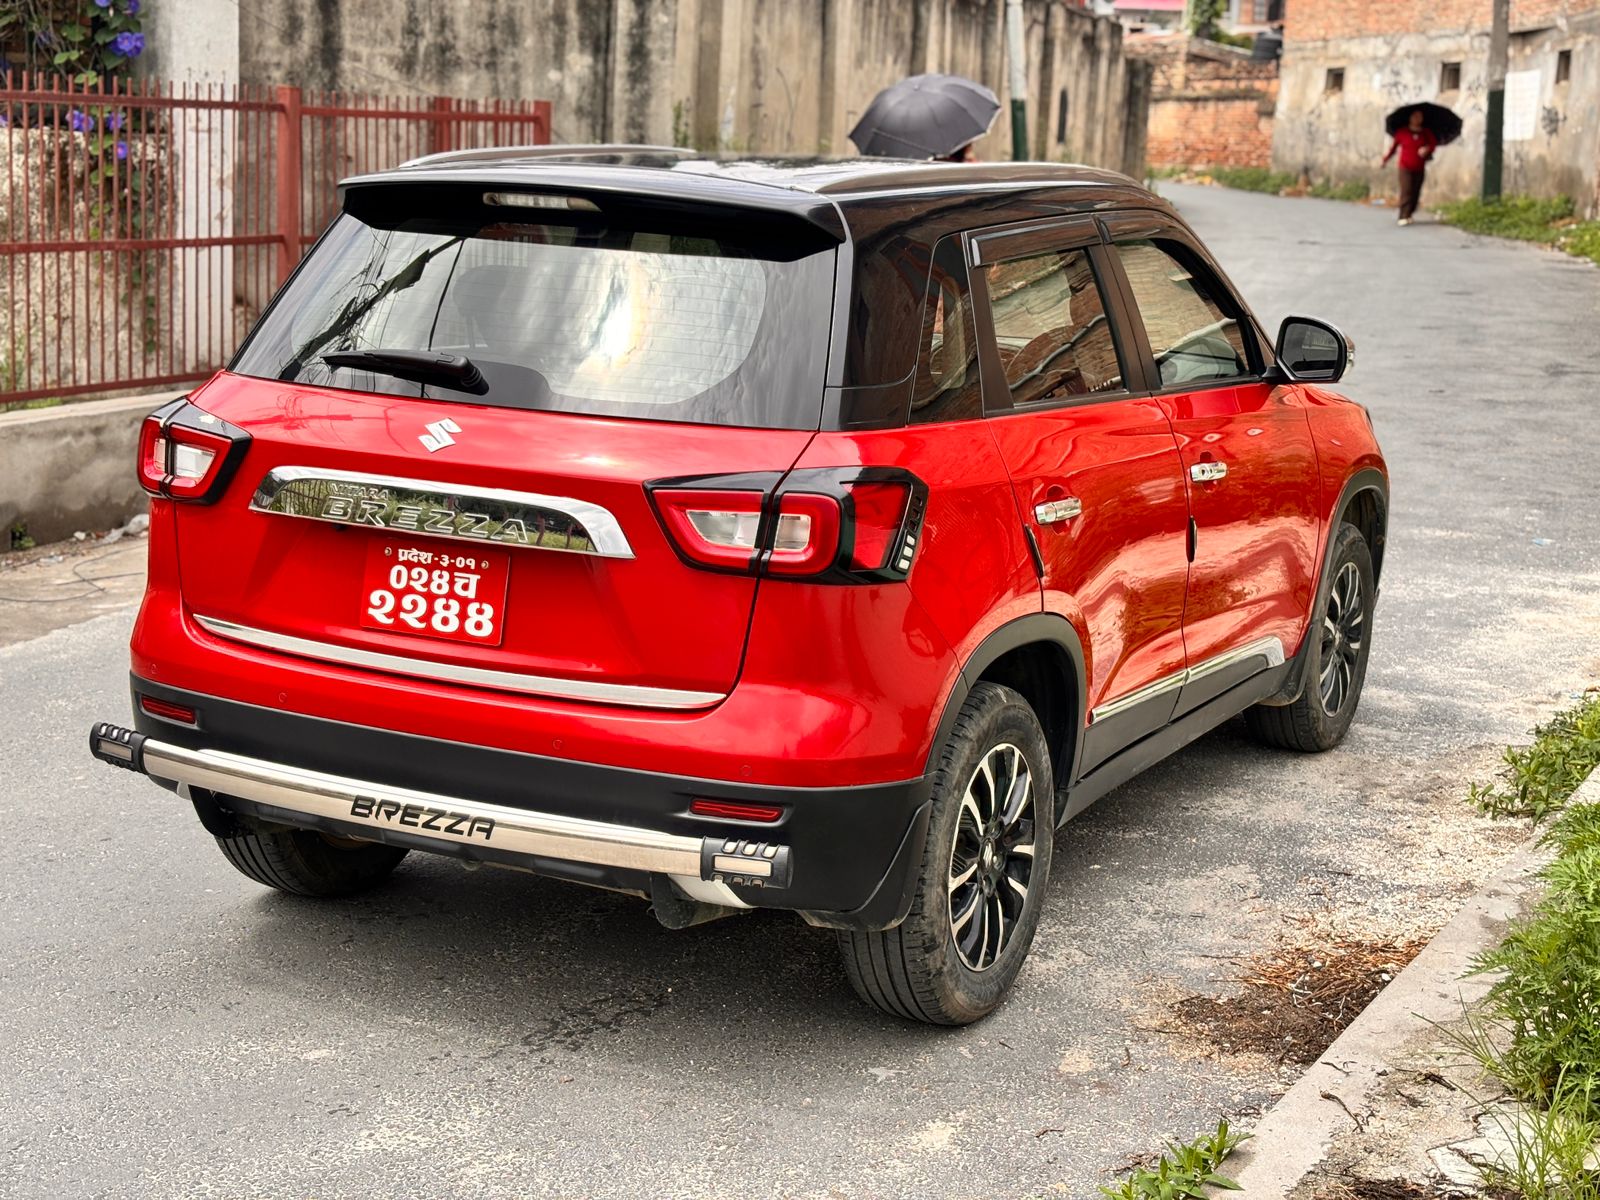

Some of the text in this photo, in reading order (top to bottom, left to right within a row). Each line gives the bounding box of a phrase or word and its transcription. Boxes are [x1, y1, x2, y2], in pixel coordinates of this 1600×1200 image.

[321, 495, 529, 544] BREZZA
[367, 589, 494, 637] २२४४
[350, 794, 496, 840] BREZZA
